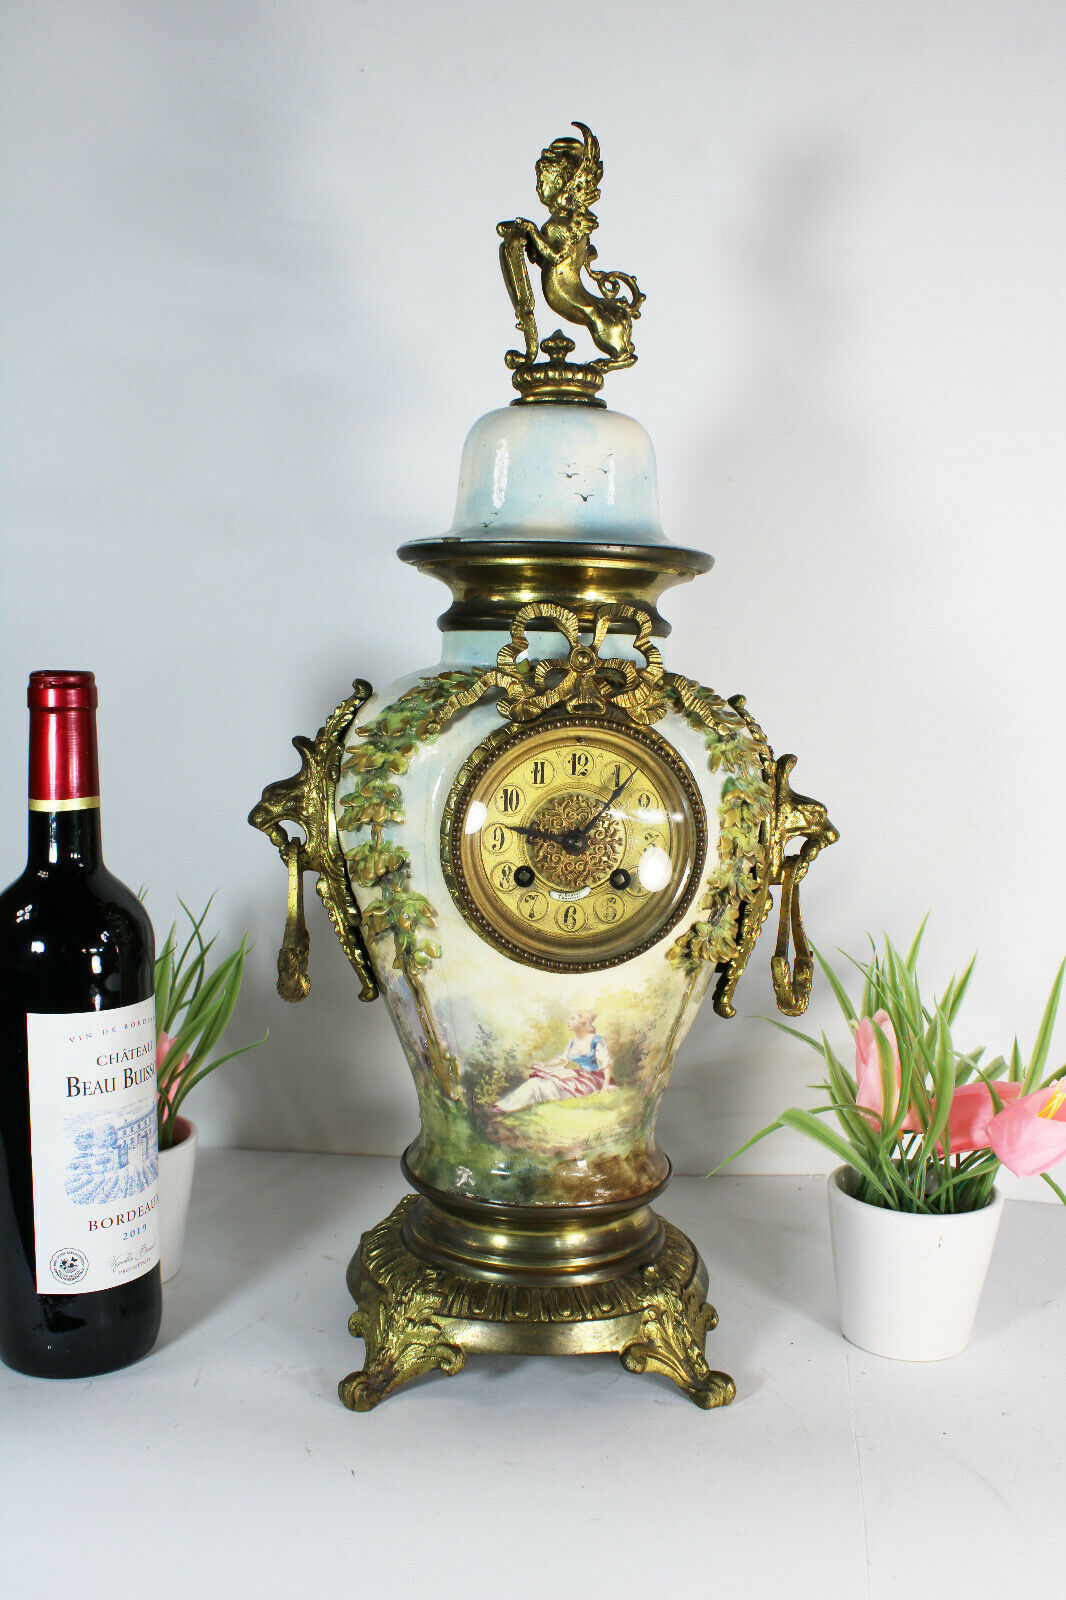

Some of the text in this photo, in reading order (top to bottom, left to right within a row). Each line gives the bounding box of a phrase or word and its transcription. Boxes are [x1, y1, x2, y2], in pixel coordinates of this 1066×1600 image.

[530, 762, 545, 785] 11
[568, 752, 588, 776] 12
[612, 763, 621, 788] 1
[500, 788, 520, 812] 10
[492, 826, 505, 851] 9
[500, 864, 513, 889] 8
[524, 895, 539, 919] 7
[564, 905, 577, 930] 6
[606, 897, 617, 921] 5
[68, 1032, 93, 1043] VIN
[102, 1026, 117, 1035] DE
[96, 1040, 153, 1067] CHÂTEAU
[122, 1223, 147, 1241] 2019
